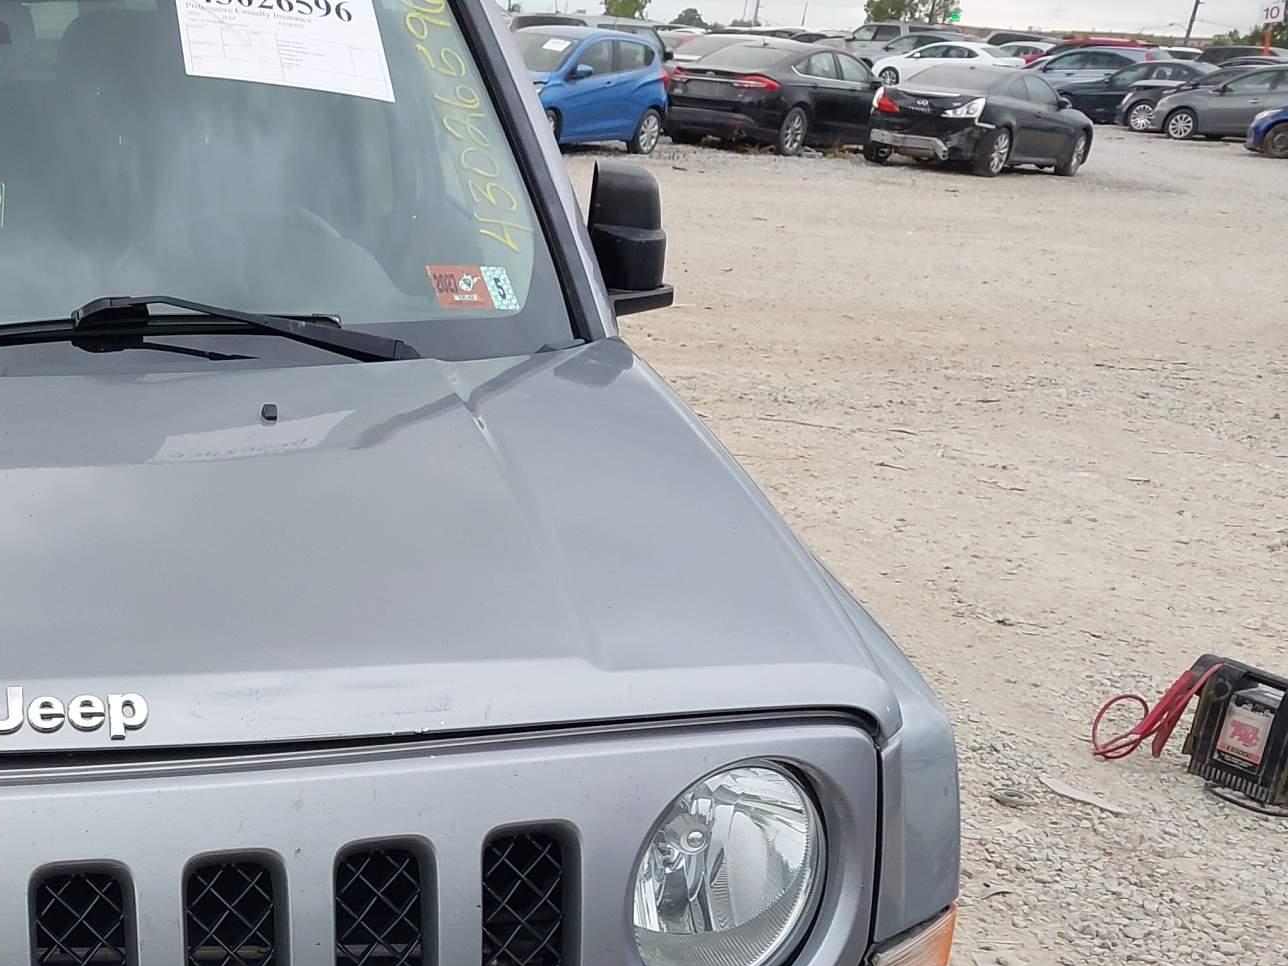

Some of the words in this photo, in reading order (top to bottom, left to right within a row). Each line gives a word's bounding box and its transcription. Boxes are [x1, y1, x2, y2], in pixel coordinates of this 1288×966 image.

[204, 0, 352, 22] 6596
[1263, 6, 1280, 20] 10
[493, 277, 507, 299] 5
